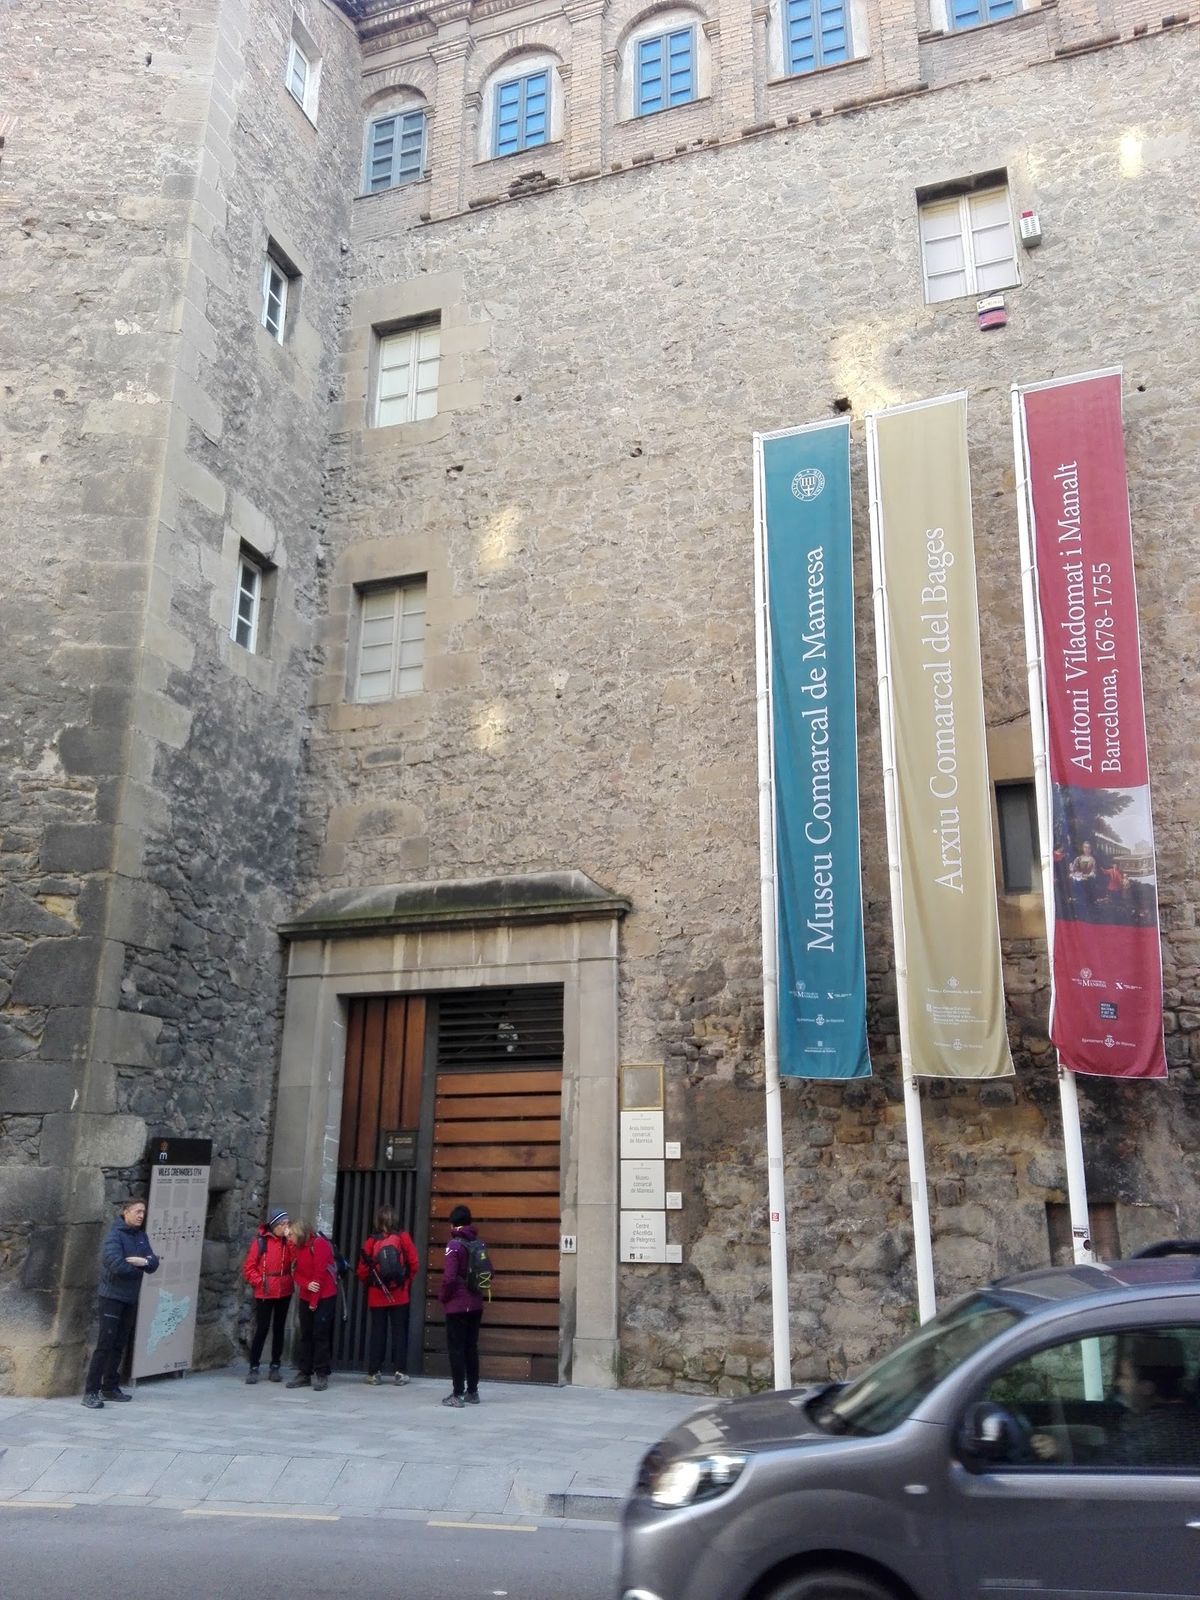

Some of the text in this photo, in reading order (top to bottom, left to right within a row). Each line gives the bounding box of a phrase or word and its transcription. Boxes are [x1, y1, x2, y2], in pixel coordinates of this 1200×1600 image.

[801, 545, 834, 952] Museu Comarcal de Manresa
[920, 526, 963, 894] Arxiu Comarcal del Bages
[1053, 460, 1092, 772] Antoni Viladomat i Manalt
[1092, 563, 1121, 772] Barcelona, 1678-1755
